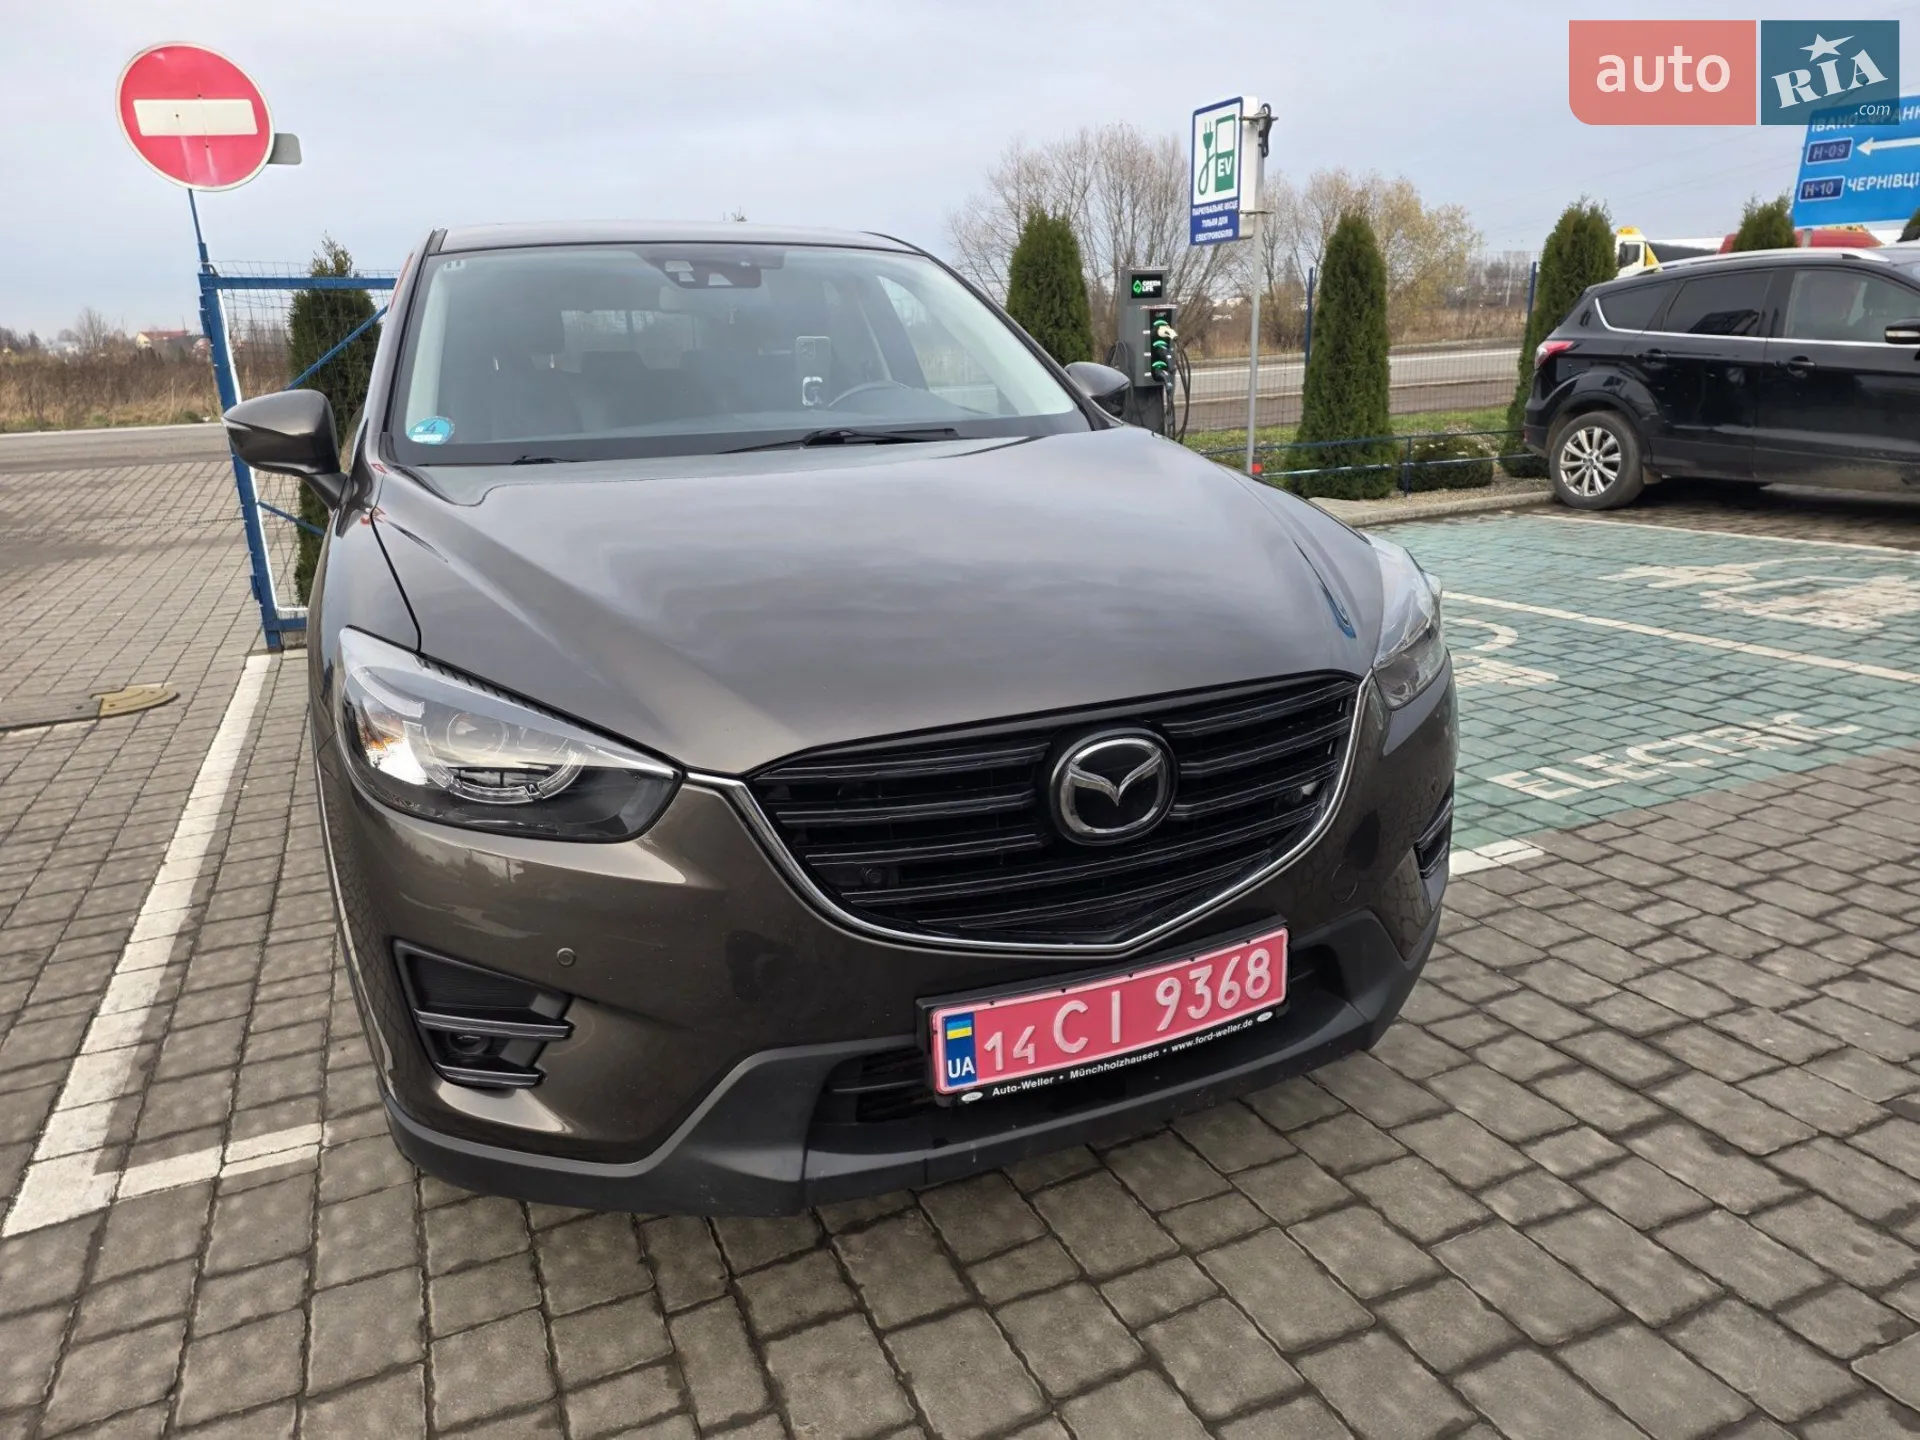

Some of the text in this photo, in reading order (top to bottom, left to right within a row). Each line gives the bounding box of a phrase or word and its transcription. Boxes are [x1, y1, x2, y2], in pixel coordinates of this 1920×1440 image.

[1217, 156, 1233, 178] EV
[1804, 171, 1920, 197] Н-10 ЧЕРНІВЦІ
[1486, 712, 1862, 800] ELECTRIC
[984, 948, 1271, 1071] 14 CI 9368
[947, 1055, 976, 1079] UA
[992, 1018, 1254, 1097] Auto-Weller Münchholzhausen www.ford-weller.de
